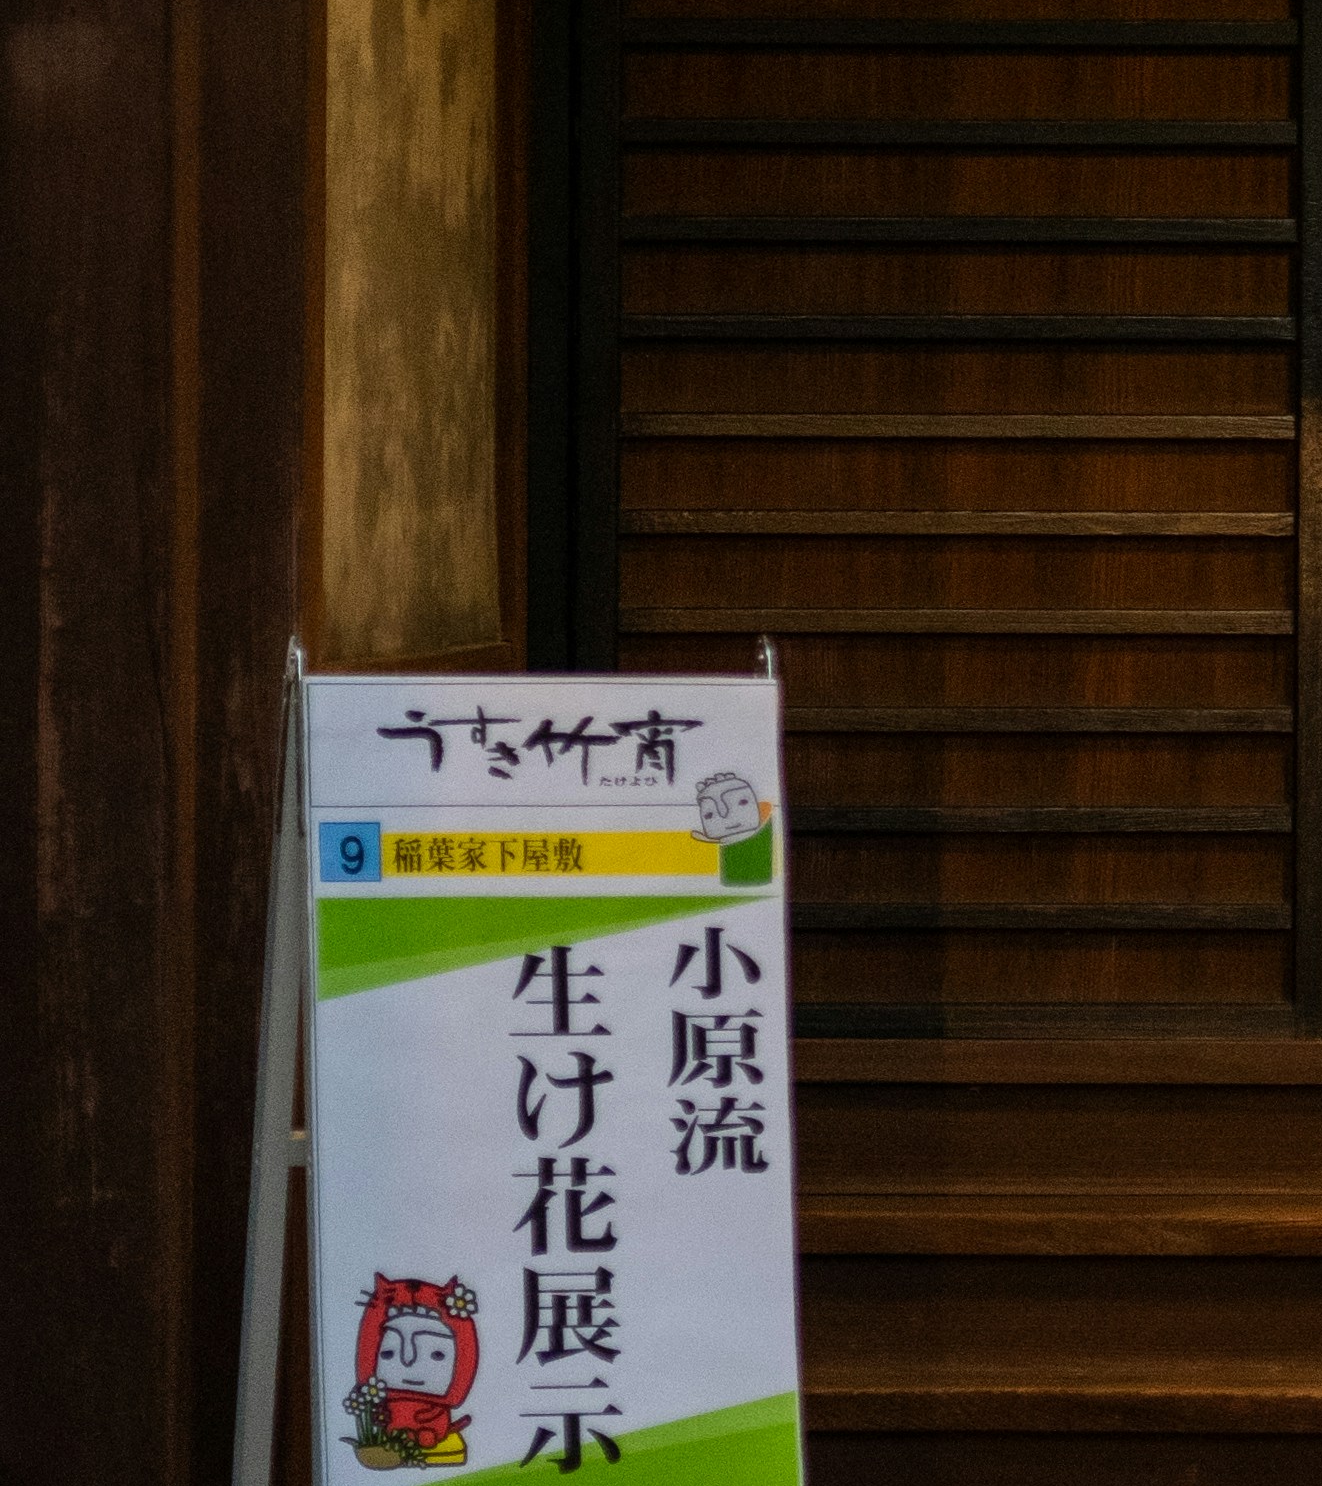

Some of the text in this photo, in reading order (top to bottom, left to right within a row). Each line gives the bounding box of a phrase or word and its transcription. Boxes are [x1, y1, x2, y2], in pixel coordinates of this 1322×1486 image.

[376, 705, 703, 787] うすき竹宵
[340, 835, 366, 876] 9
[392, 837, 584, 874] 稲葉家下屋敷
[666, 926, 770, 1176] 小原流
[508, 945, 622, 1475] 生け花展示
